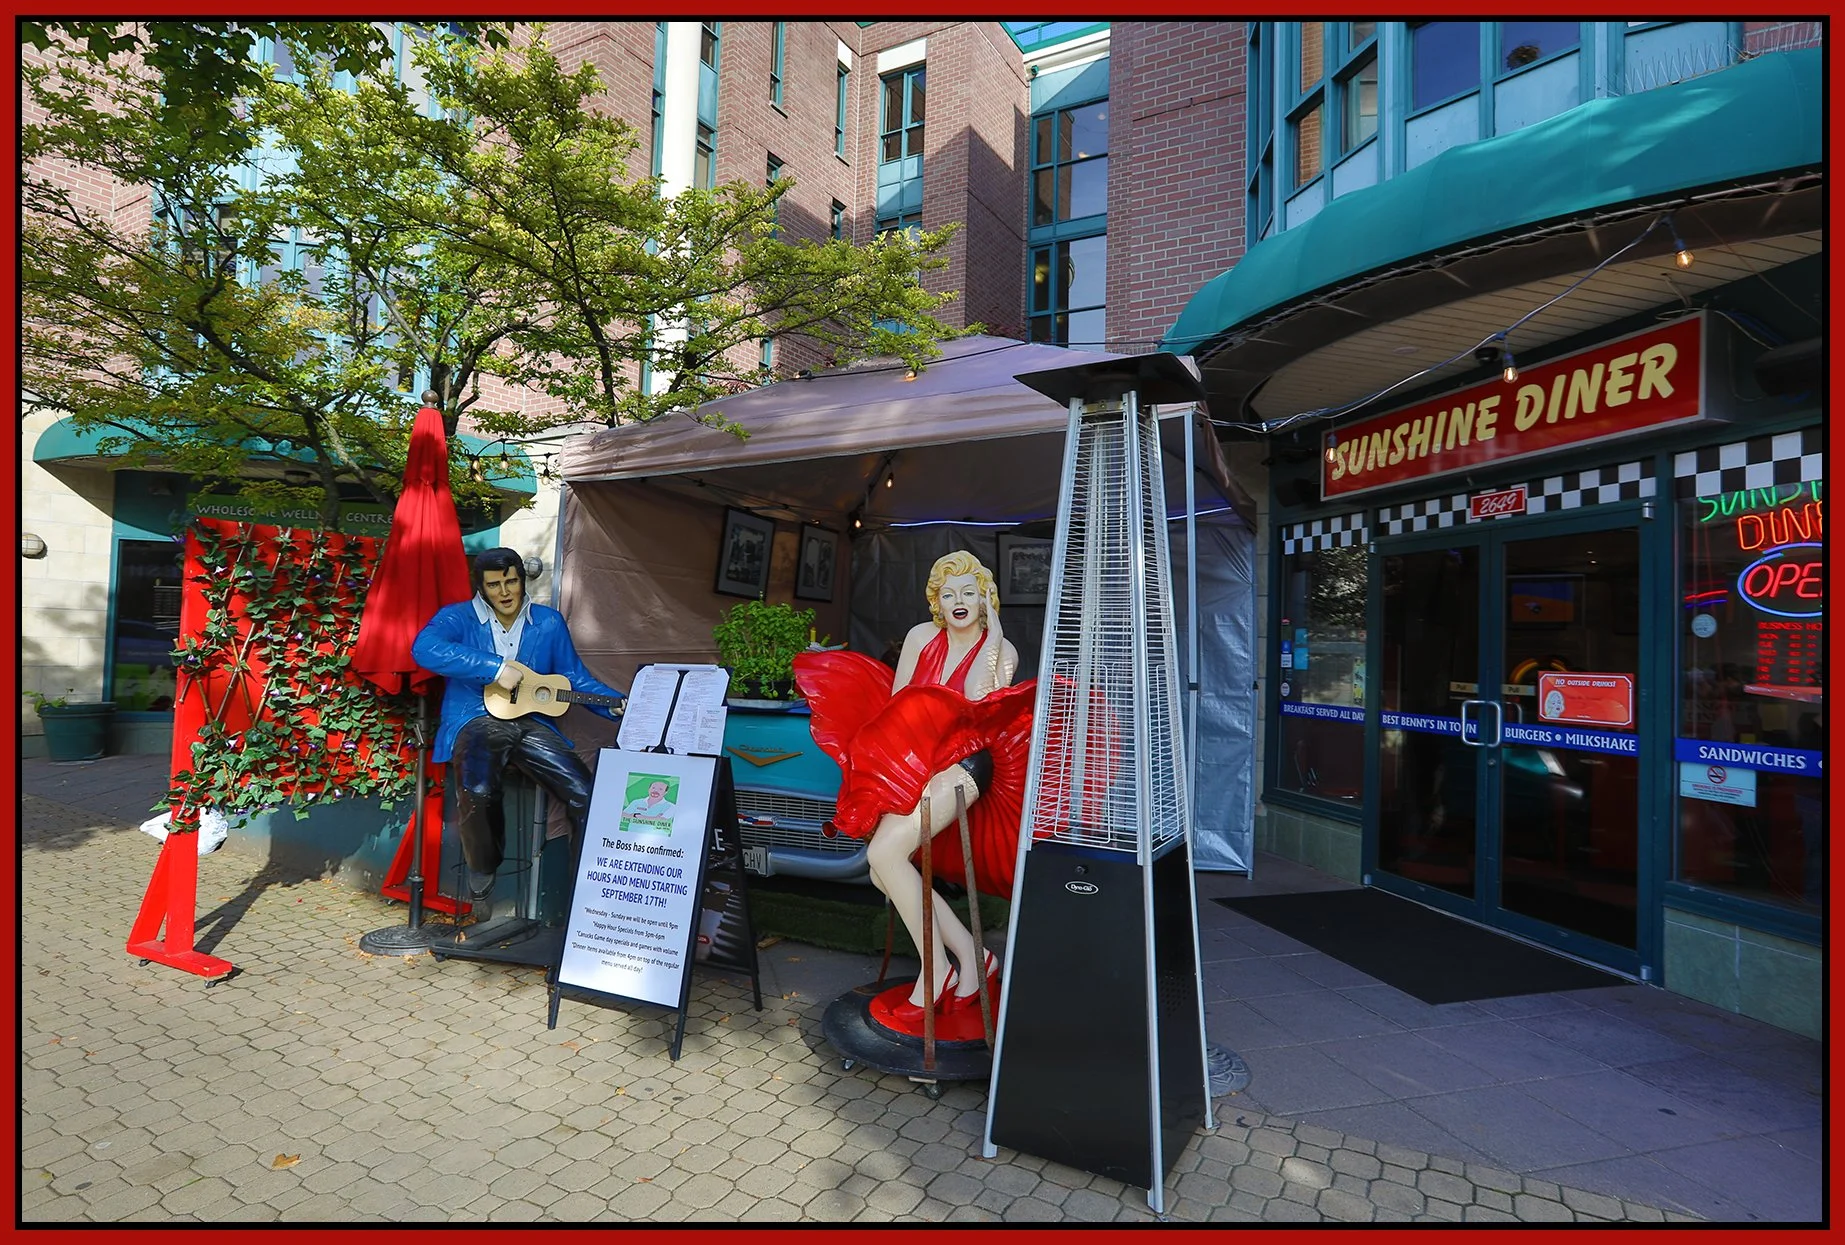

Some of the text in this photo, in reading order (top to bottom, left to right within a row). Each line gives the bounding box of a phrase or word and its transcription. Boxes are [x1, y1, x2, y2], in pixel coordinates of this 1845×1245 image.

[1331, 342, 1678, 481] SUNSHINE DINER
[196, 504, 277, 518] WHOLESOE
[1480, 492, 1518, 514] 2649
[1283, 704, 1365, 721] BREAKFAST SERVED ALL DAY
[1382, 714, 1400, 725] BEST
[1436, 720, 1447, 731] IN
[1505, 727, 1636, 752] BURGERS MILKSHAKE
[1699, 746, 1807, 770] SANDWICHES
[602, 837, 684, 859] The Boss has confirmed:
[597, 856, 683, 879] WE ARE EXTENDING OUR
[587, 870, 688, 896] HOURS AND MENU STARTING
[601, 887, 667, 909] SEPTEMBER 17TH!
[607, 923, 617, 931] Hour
[617, 925, 634, 935] Specials
[634, 928, 645, 936] from
[611, 911, 626, 921] Sunday
[633, 915, 641, 923] will
[669, 922, 679, 930] 9pm
[594, 933, 606, 942] Game
[613, 938, 630, 947] specials
[630, 941, 638, 949] and
[639, 943, 652, 952] games
[653, 945, 662, 953] with
[662, 947, 679, 957] volume
[587, 945, 598, 953] items
[598, 948, 616, 957] available
[617, 950, 627, 959] from
[664, 960, 680, 970] regular
[613, 962, 627, 970] served
